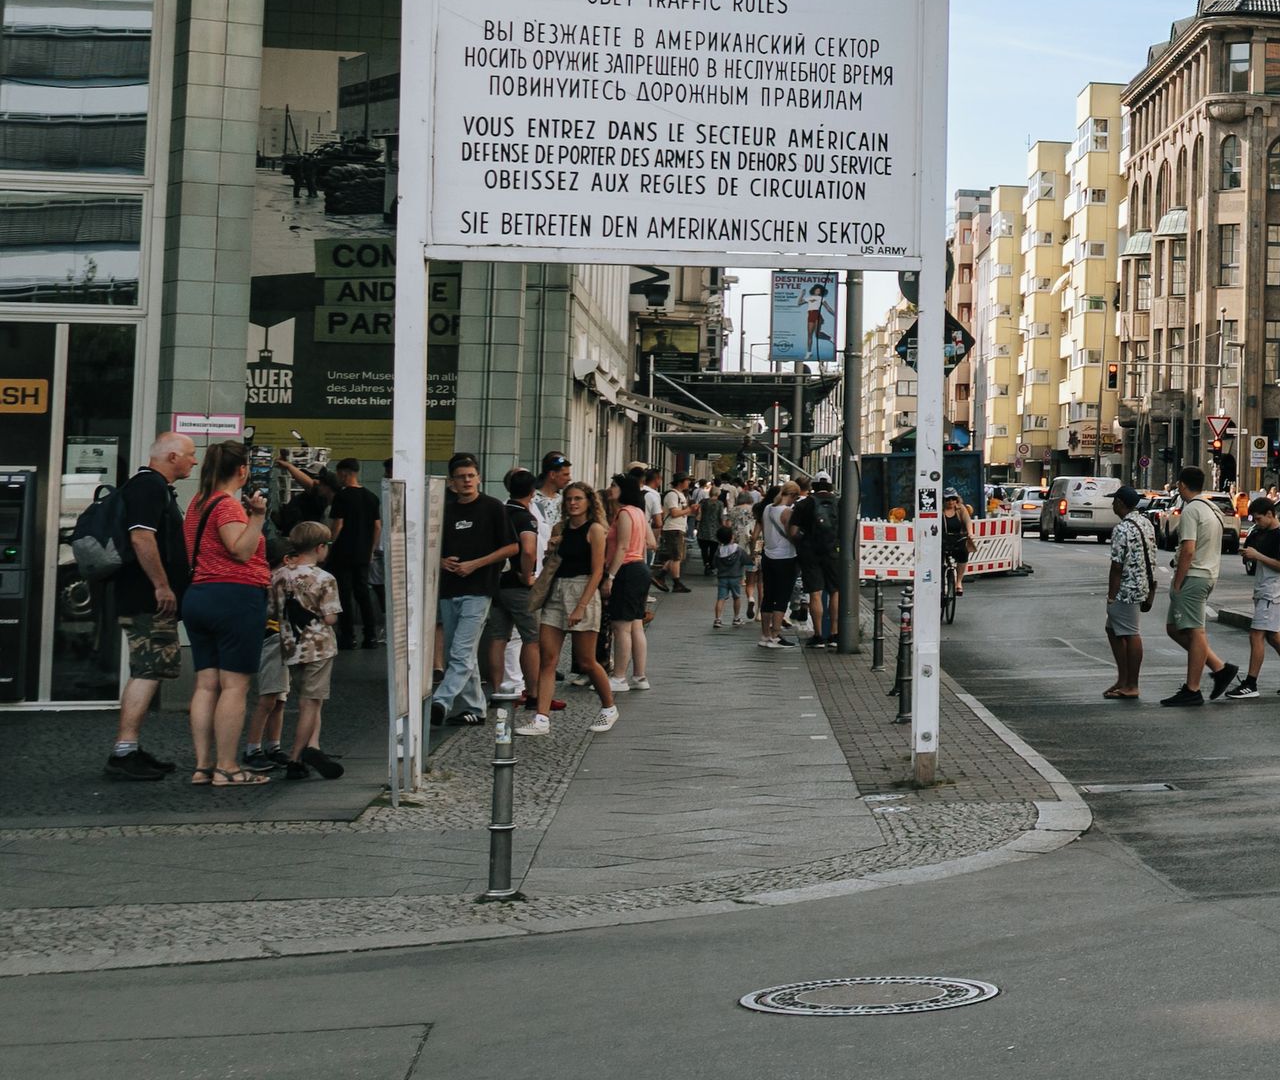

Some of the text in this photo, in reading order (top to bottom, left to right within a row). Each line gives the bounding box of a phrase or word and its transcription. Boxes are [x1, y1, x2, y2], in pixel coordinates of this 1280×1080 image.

[485, 20, 512, 41] ВЫ
[656, 29, 805, 55] АМЕРИКАНСКИЙ
[815, 37, 879, 58] СЕКТОР
[465, 47, 527, 69] НОСИТЬ
[533, 50, 598, 72] ОРУЖИЕ
[604, 53, 698, 77] ЗАПРЕЩЕНО
[725, 59, 836, 83] НЕСЛУЖЕБНОЕ
[844, 64, 892, 85] ВРЕМЯ
[636, 82, 747, 105] ДОРОЖНЫМ
[762, 87, 862, 111] ПРАВИЛАМ
[464, 116, 888, 152] VOUS ENTREZ DANS LE SECTEUR AMÉRICAIN
[462, 142, 892, 175] DEFENSE DE PORTER DES ARMES EN DEHORS DU SERVICE
[485, 170, 865, 200] OBEISSEZ AUX REGLES DE CIRCULATION
[460, 211, 885, 245] SIE BETRETEN DEN AMERIKANISCHEN SEKTOR
[861, 246, 906, 256] US ARMY
[775, 275, 834, 284] DESTINATION
[327, 312, 395, 335] PAR
[327, 371, 360, 380] Unser
[327, 383, 347, 393] des
[349, 383, 385, 393] Jahres
[436, 384, 450, 394] 22
[1, 387, 39, 405] SH
[326, 395, 368, 406] Tickets
[370, 396, 391, 406] hier
